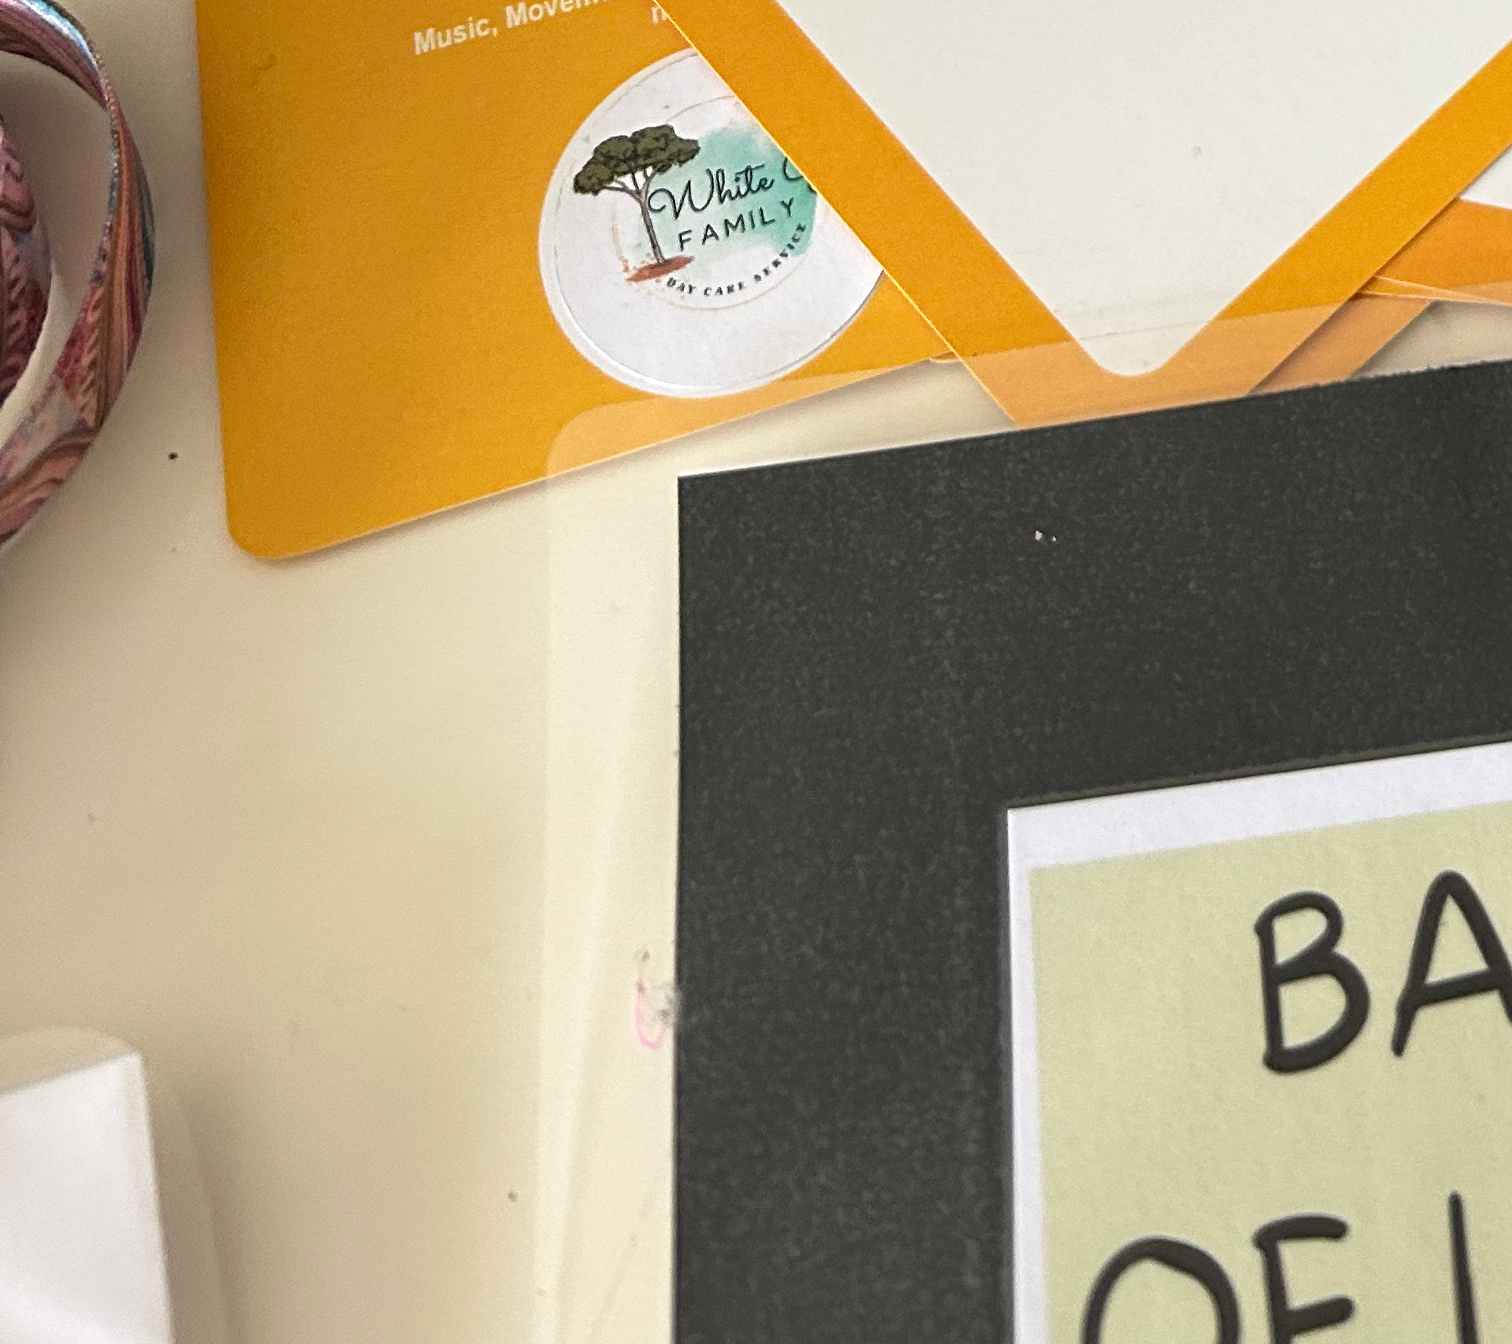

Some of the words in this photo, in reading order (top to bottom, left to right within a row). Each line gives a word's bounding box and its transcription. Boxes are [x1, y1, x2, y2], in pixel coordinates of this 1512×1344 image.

[413, 16, 498, 54] Music,
[648, 164, 775, 220] White
[677, 197, 794, 252] FAMILY
[1081, 1214, 1354, 1344] OF
